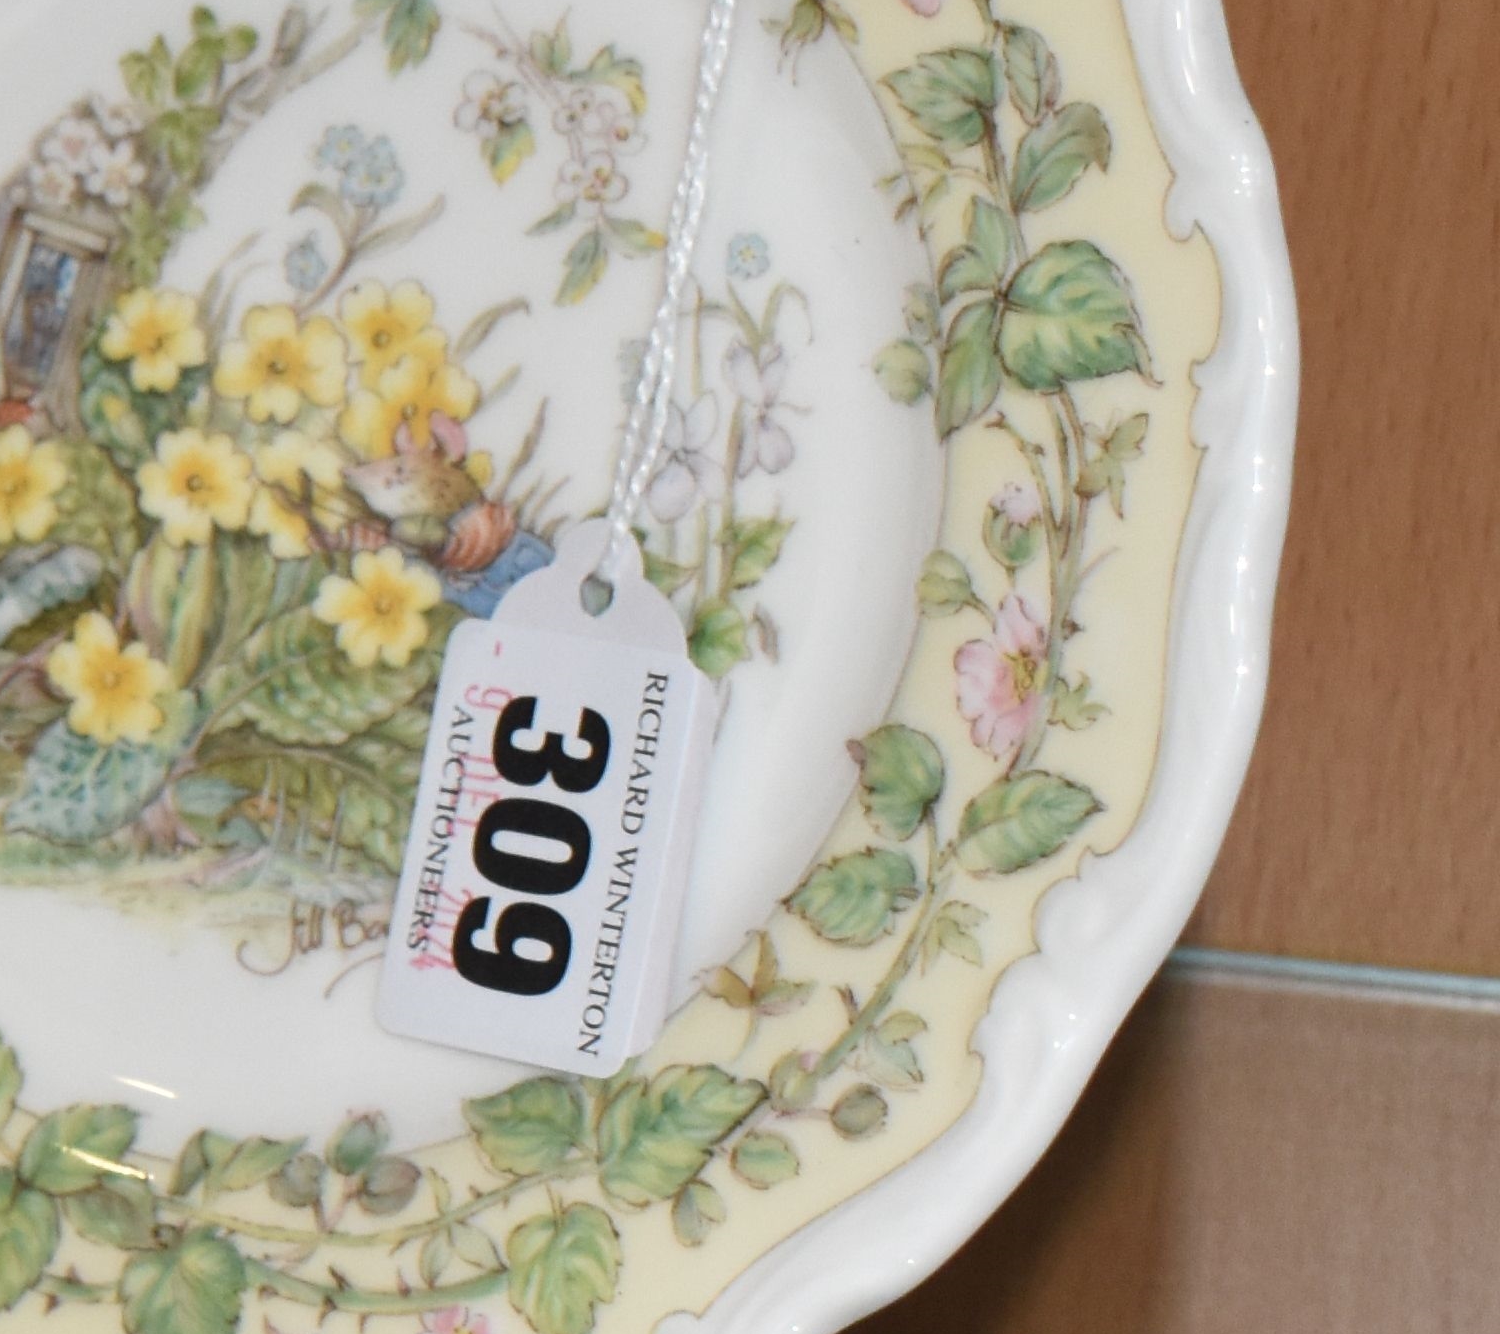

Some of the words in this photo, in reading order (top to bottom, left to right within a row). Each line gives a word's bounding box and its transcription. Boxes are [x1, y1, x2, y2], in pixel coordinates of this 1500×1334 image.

[406, 705, 475, 955] AUCTIONEERS
[451, 695, 612, 997] 309
[620, 670, 669, 835] RICHARD
[578, 845, 639, 1058] WINTERTON
